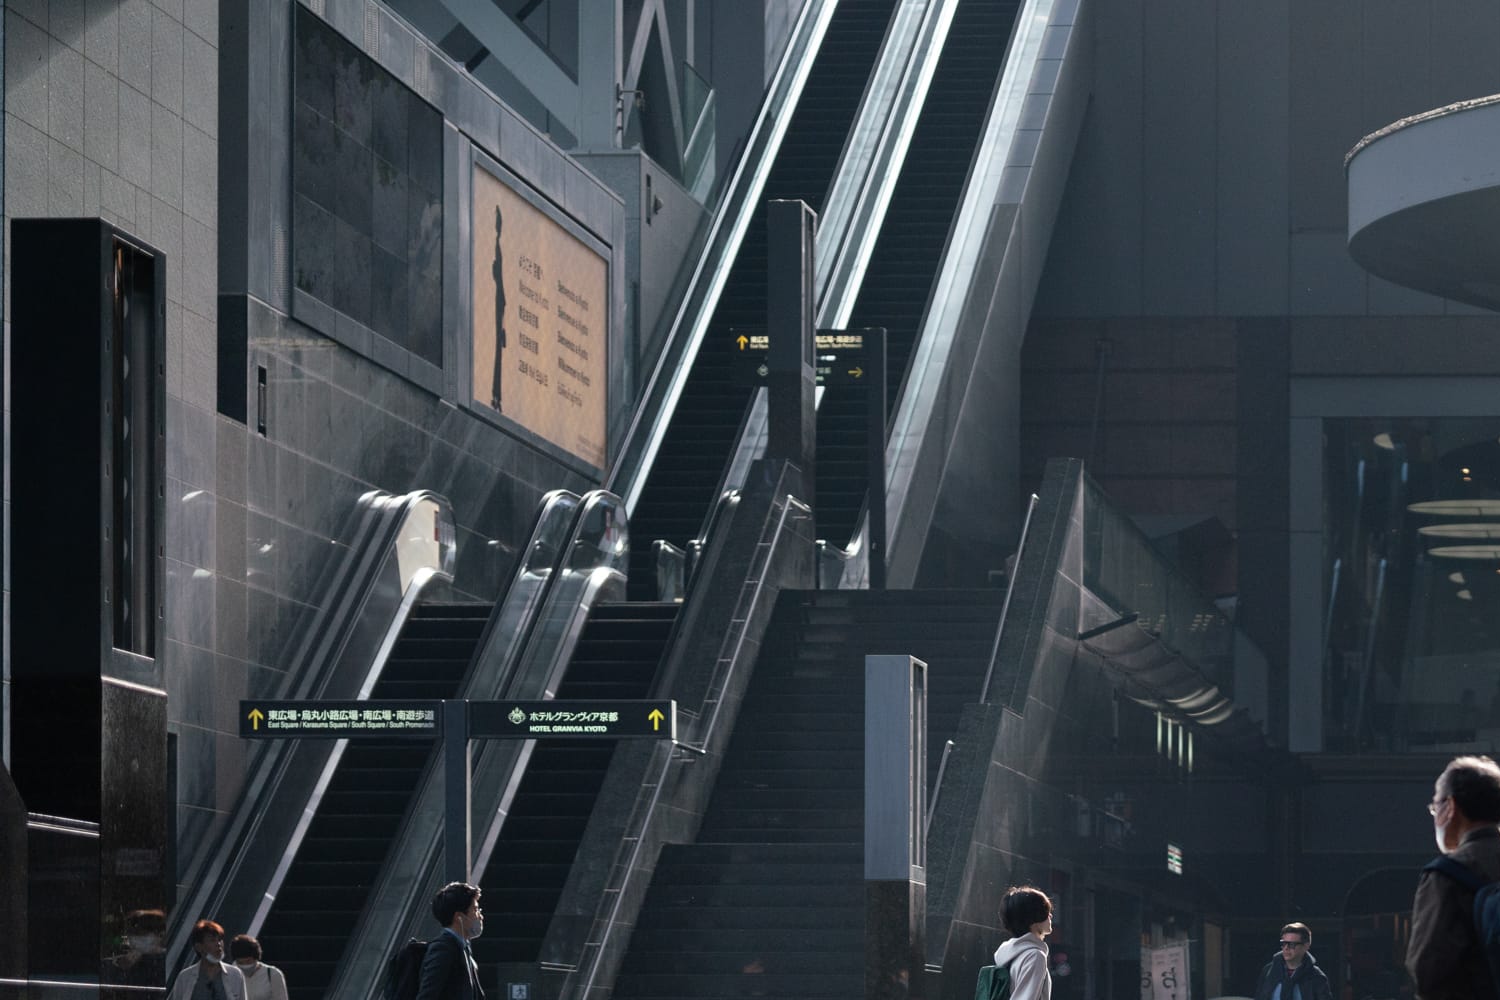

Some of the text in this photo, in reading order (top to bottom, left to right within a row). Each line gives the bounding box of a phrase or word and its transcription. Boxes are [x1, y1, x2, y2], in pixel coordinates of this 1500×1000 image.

[529, 711, 619, 722] ホテルグランヴィア京都
[267, 721, 280, 729] East
[280, 721, 299, 730] Square
[302, 721, 329, 729] Karasuma
[329, 721, 348, 730] Square
[351, 721, 367, 729] South
[367, 721, 386, 730] Square
[389, 721, 405, 729] South
[529, 725, 608, 733] HOTEL GRANVIA KYOTO
